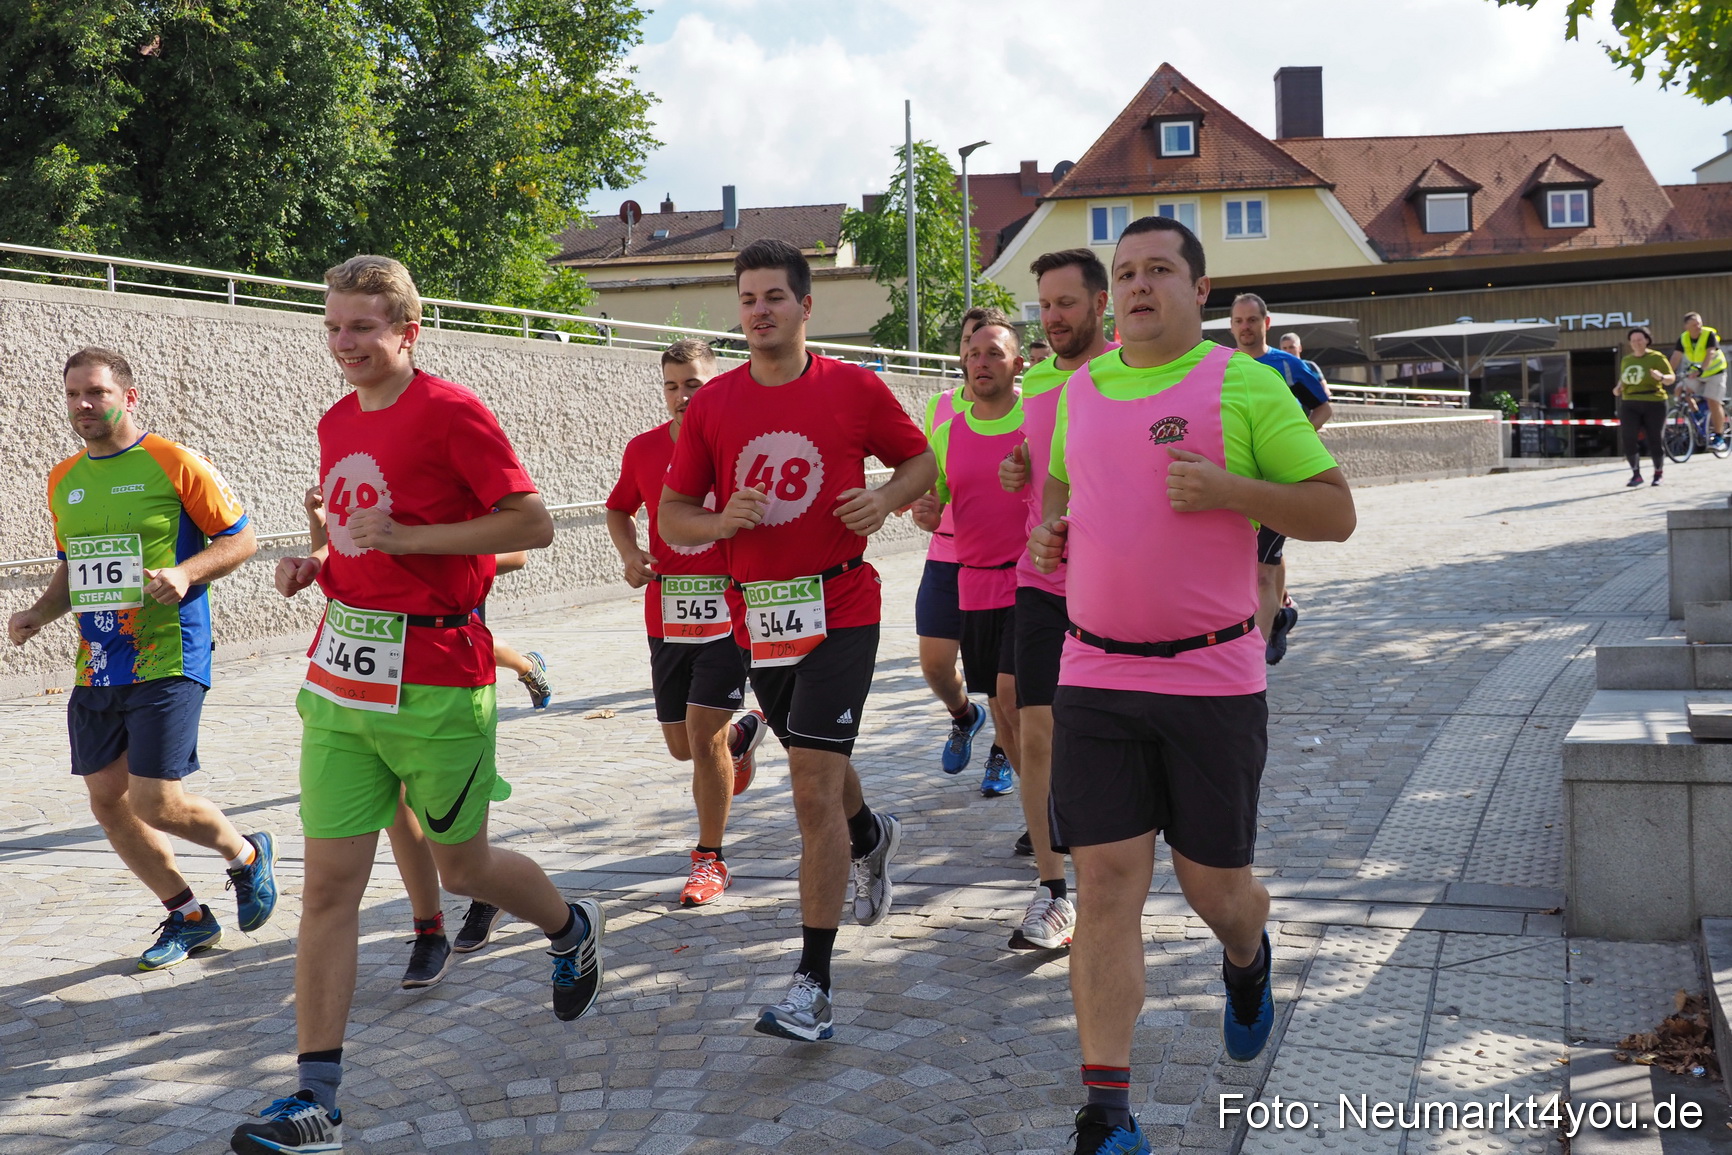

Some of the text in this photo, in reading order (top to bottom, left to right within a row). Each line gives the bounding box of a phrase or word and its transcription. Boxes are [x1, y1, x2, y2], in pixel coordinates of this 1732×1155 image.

[1495, 311, 1650, 331] NTRAL
[111, 484, 145, 495] BOCK
[69, 537, 134, 558] BOCK
[78, 561, 123, 586] 116
[665, 577, 727, 594] BOCK
[745, 579, 815, 606] BOCK
[79, 591, 123, 604] STEFAN
[676, 599, 718, 620] 545
[681, 624, 704, 636] FLO
[760, 609, 804, 638] 544
[325, 635, 377, 677] 546
[769, 642, 797, 657] TOBI
